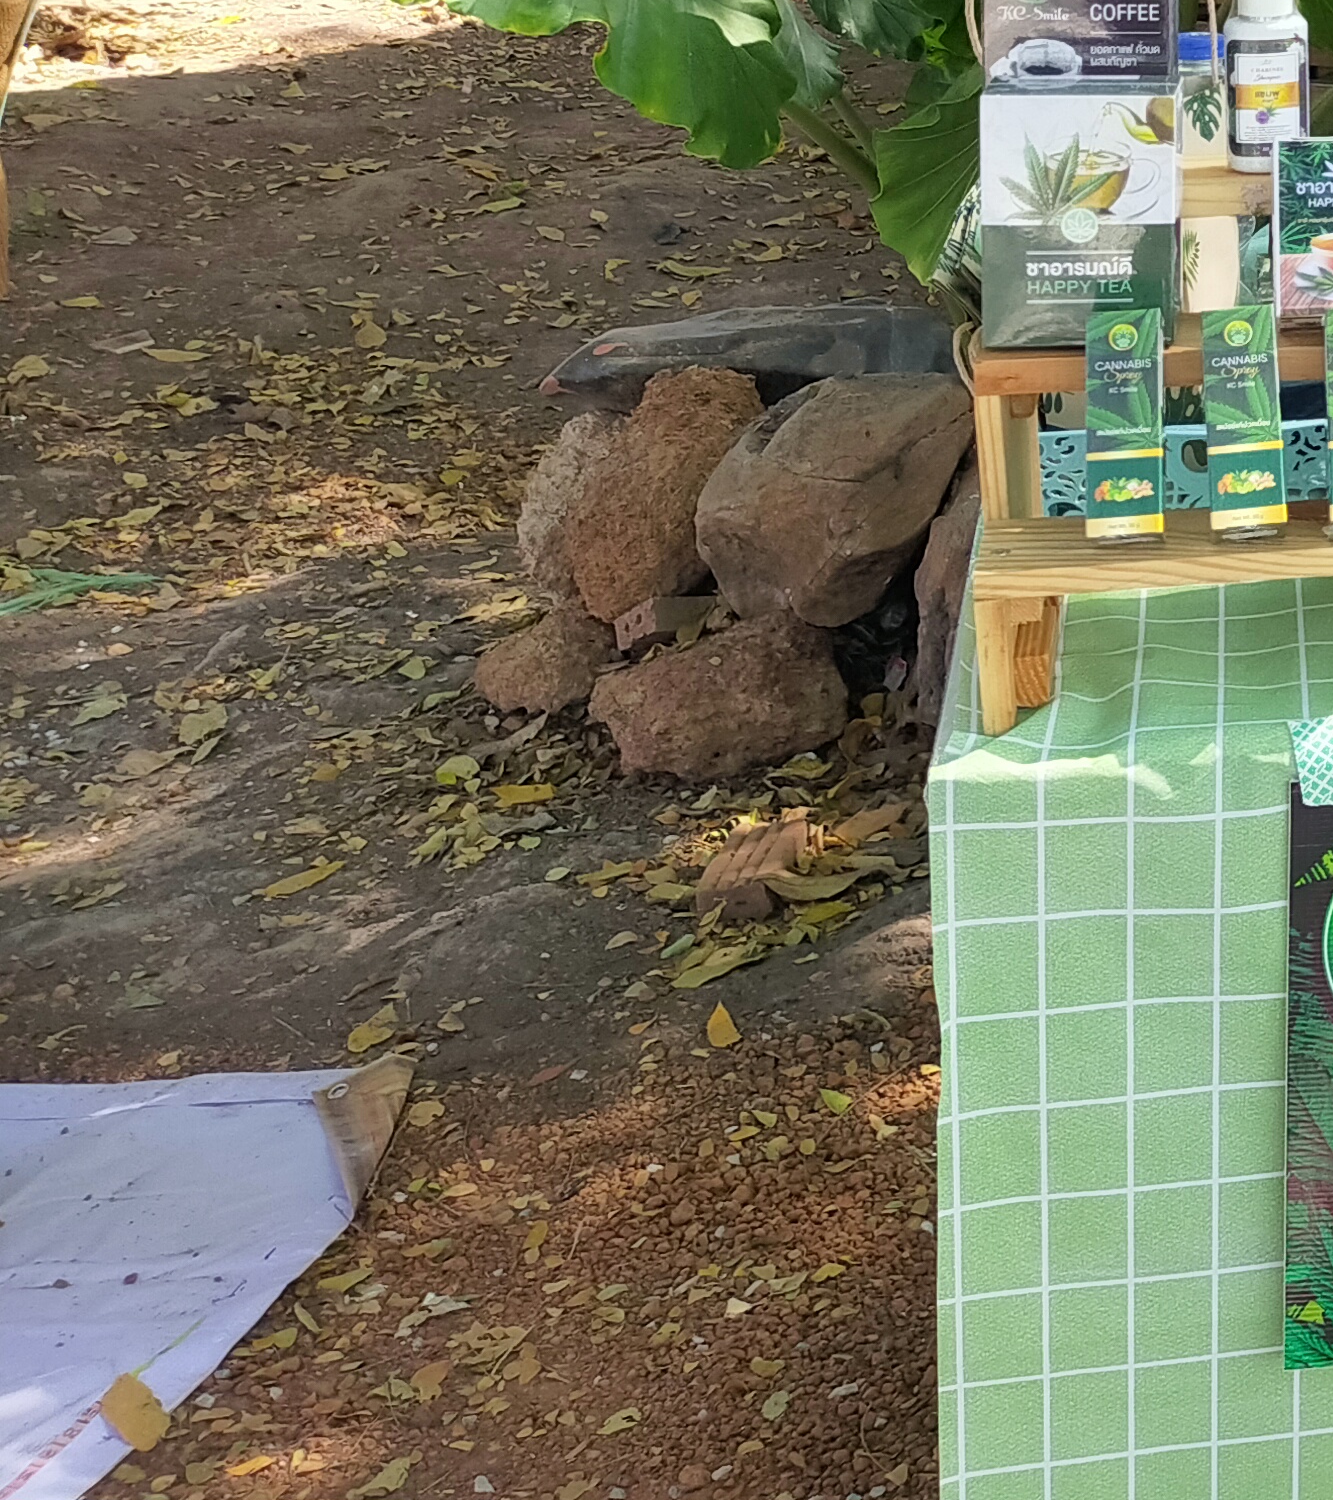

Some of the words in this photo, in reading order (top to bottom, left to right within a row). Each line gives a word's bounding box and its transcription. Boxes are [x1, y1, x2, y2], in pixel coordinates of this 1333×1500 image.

[1090, 3, 1160, 22] COFFEE
[1026, 256, 1133, 277] ชาอารมณ์ดี
[1027, 280, 1091, 295] HAPPY
[1097, 279, 1133, 294] TEA
[1094, 358, 1152, 372] CANNABIS
[1211, 353, 1268, 367] CANNABIS
